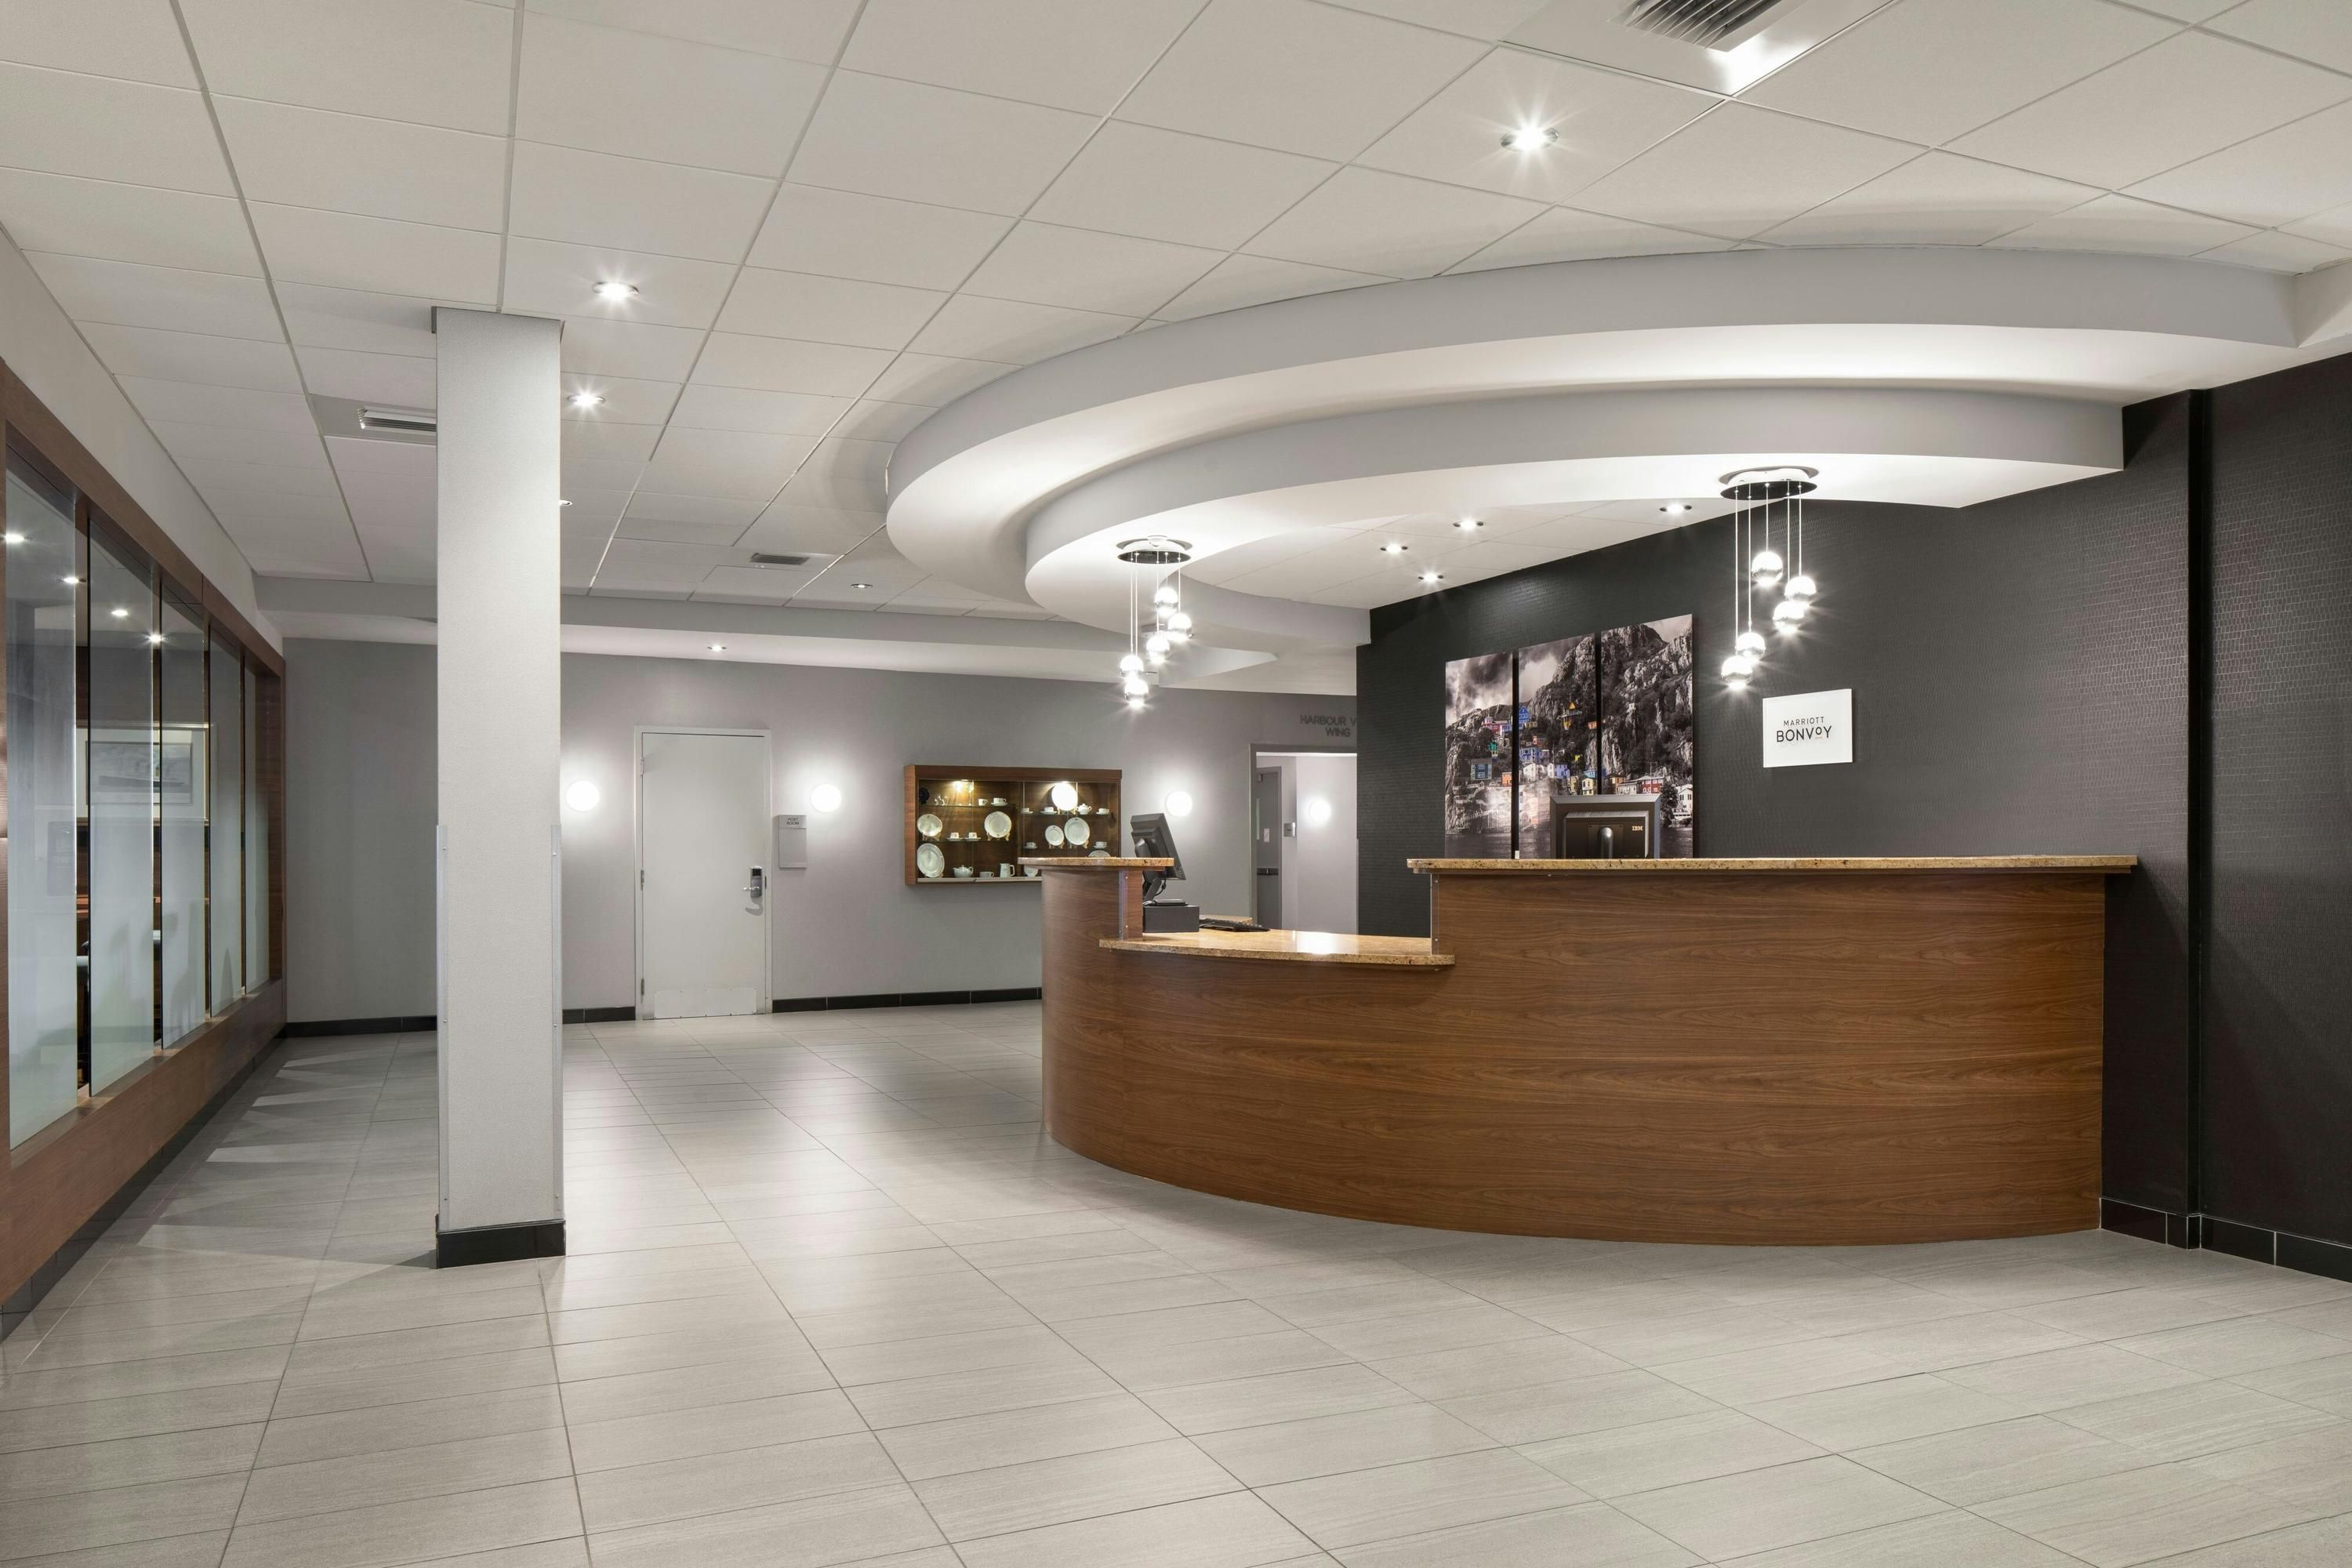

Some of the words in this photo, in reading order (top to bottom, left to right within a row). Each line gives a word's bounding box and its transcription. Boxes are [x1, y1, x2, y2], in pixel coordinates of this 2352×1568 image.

[1300, 714, 1347, 726] HARBOUR
[1783, 716, 1824, 727] MARRIOTT
[1325, 727, 1351, 738] WING
[1776, 725, 1832, 742] BONVOY
